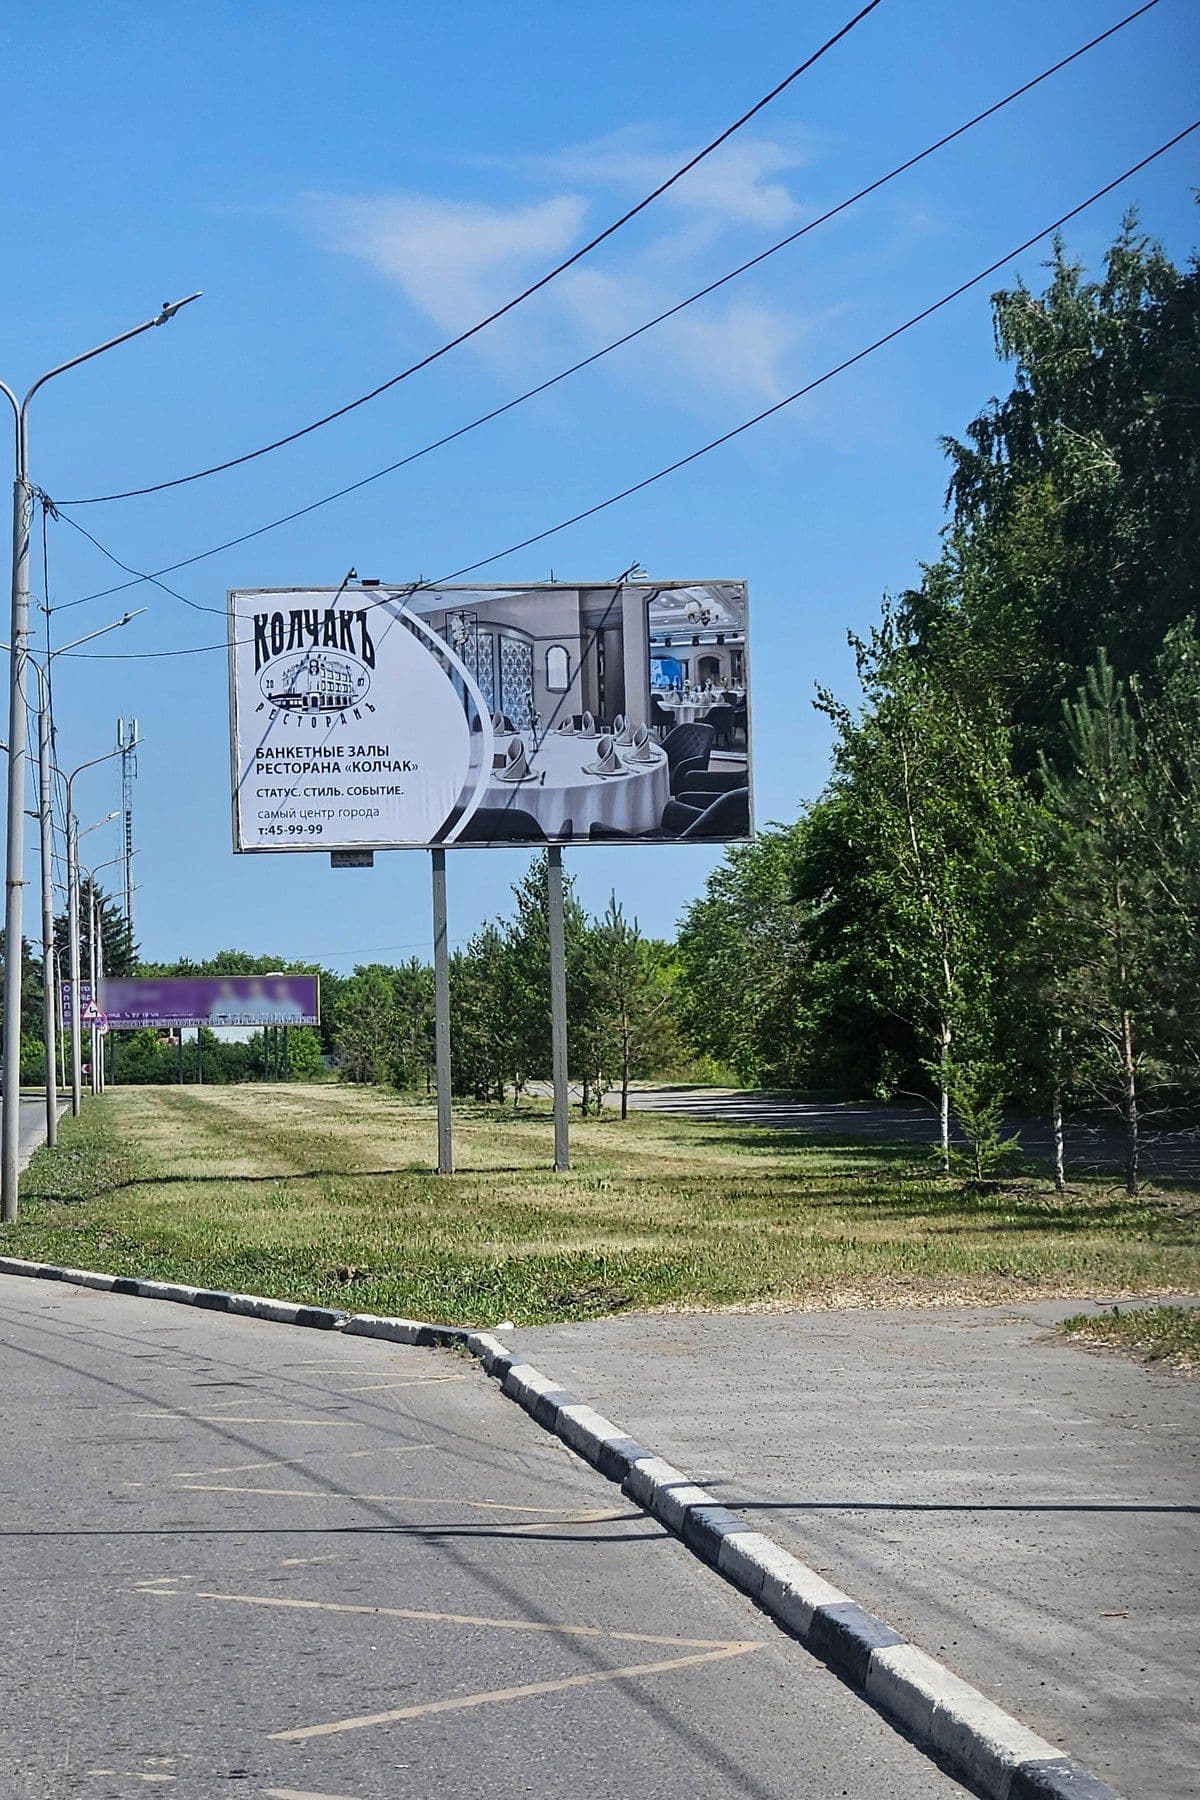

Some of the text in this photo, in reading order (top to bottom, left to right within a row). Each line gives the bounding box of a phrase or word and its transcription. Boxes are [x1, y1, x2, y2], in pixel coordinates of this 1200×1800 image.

[253, 609, 376, 676] КОЛЧАКЪ
[266, 679, 274, 689] 20
[255, 702, 376, 728] РЕСТОРАНЪ
[256, 745, 389, 759] БАНКЕТНЫЕ ЗАЛЫ
[256, 760, 418, 775] РЕСТОРАНА «КОЛЧАК»
[256, 785, 404, 798] СТАТУС. СТИЛЬ. СОБЫТИЕ.
[257, 808, 380, 820] самый центр города
[258, 824, 323, 836] т:45-99-99
